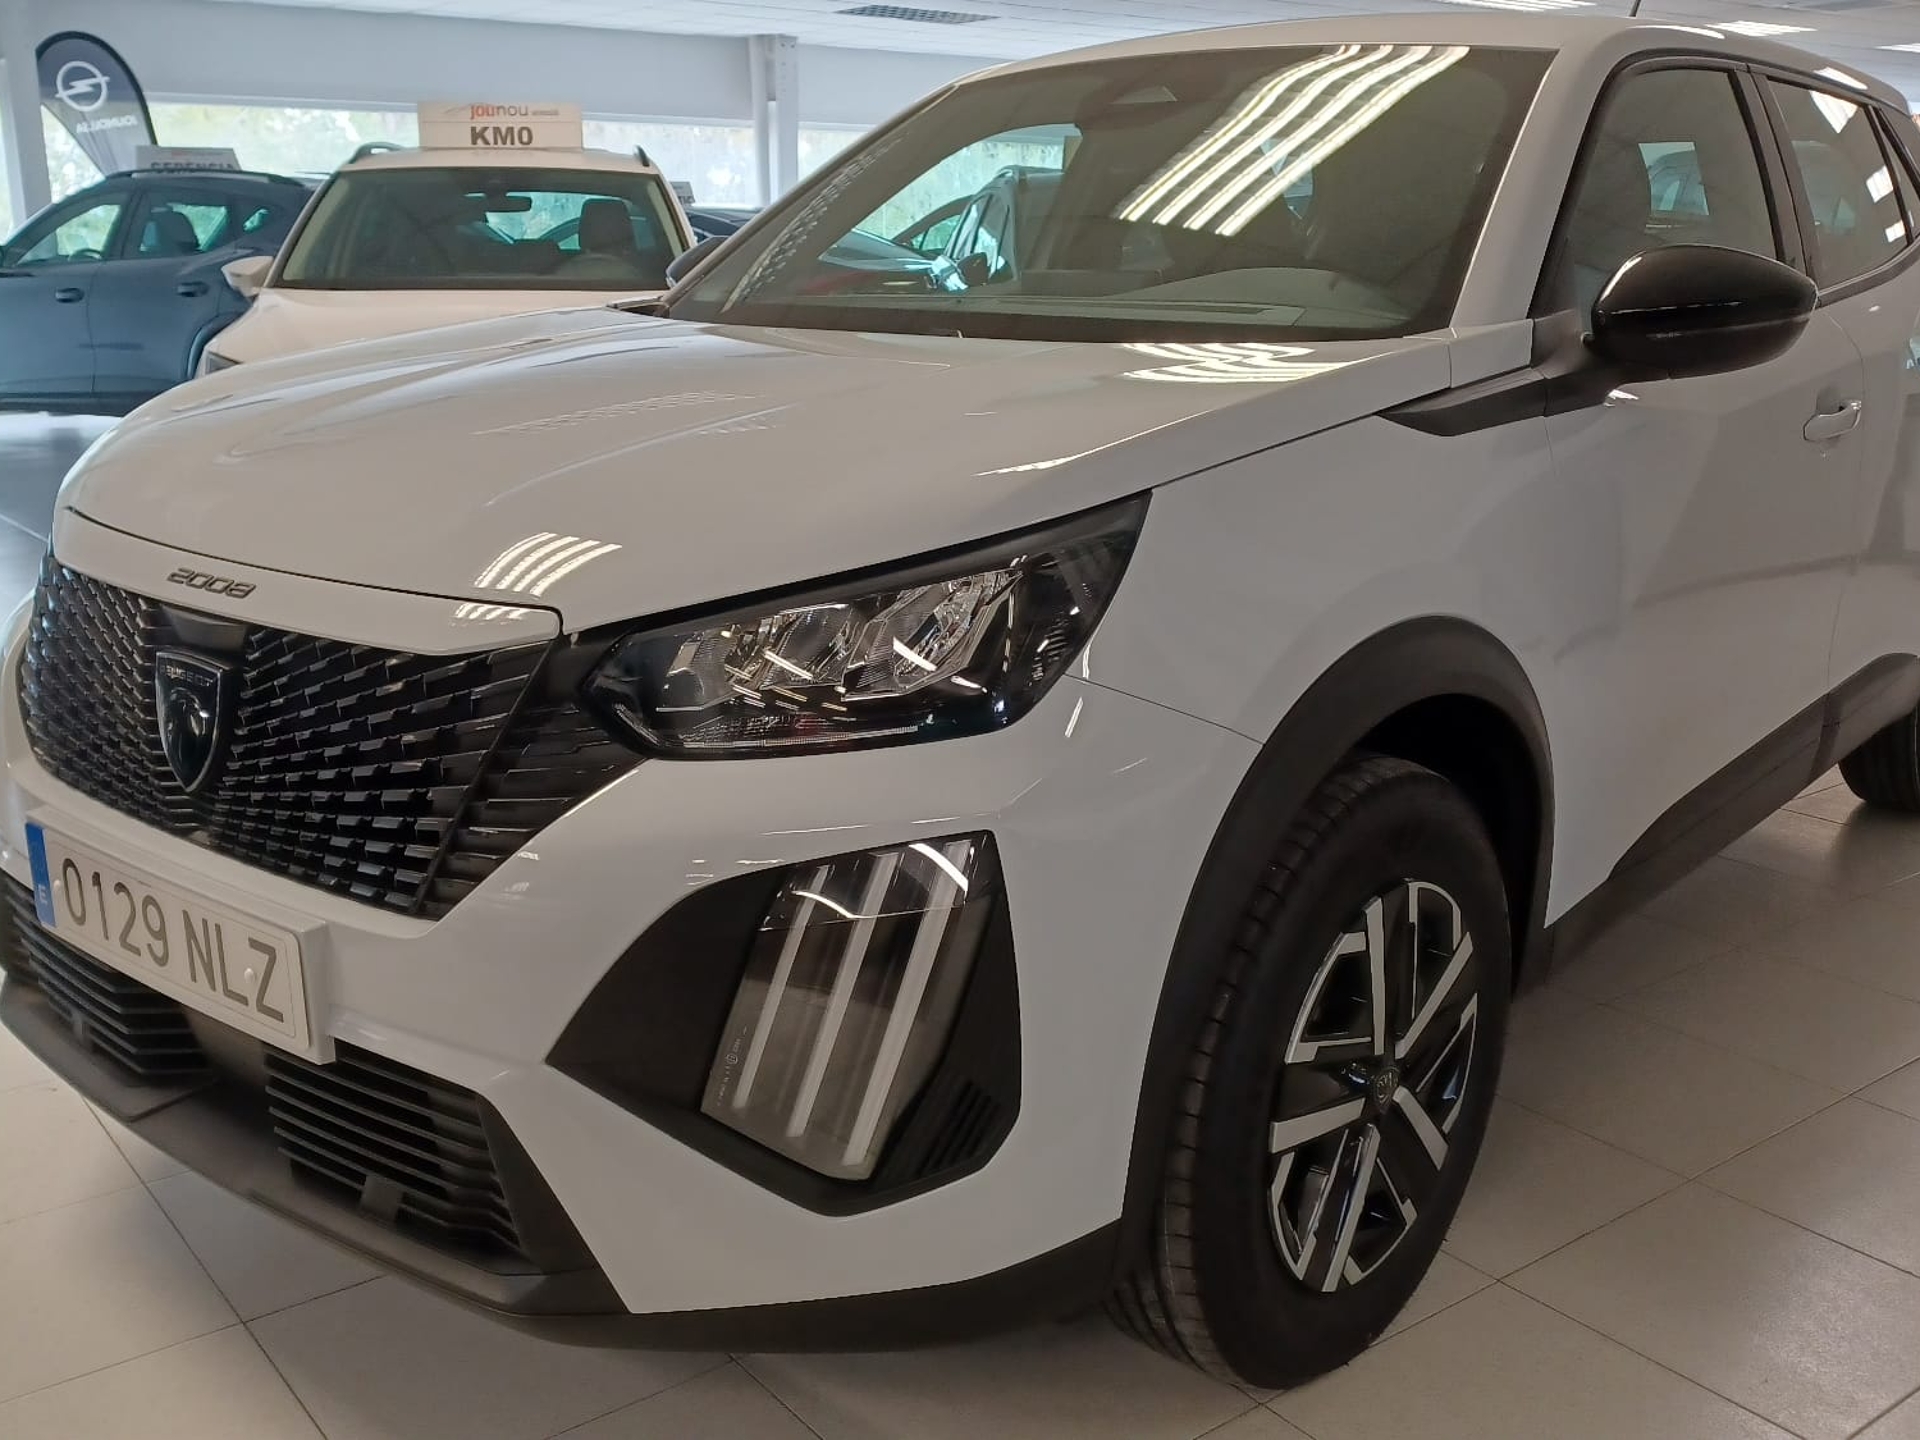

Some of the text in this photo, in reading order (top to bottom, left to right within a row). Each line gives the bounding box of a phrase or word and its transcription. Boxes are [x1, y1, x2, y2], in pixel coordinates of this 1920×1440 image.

[167, 567, 257, 599] 2008
[62, 858, 284, 1023] 0129 NLZ
